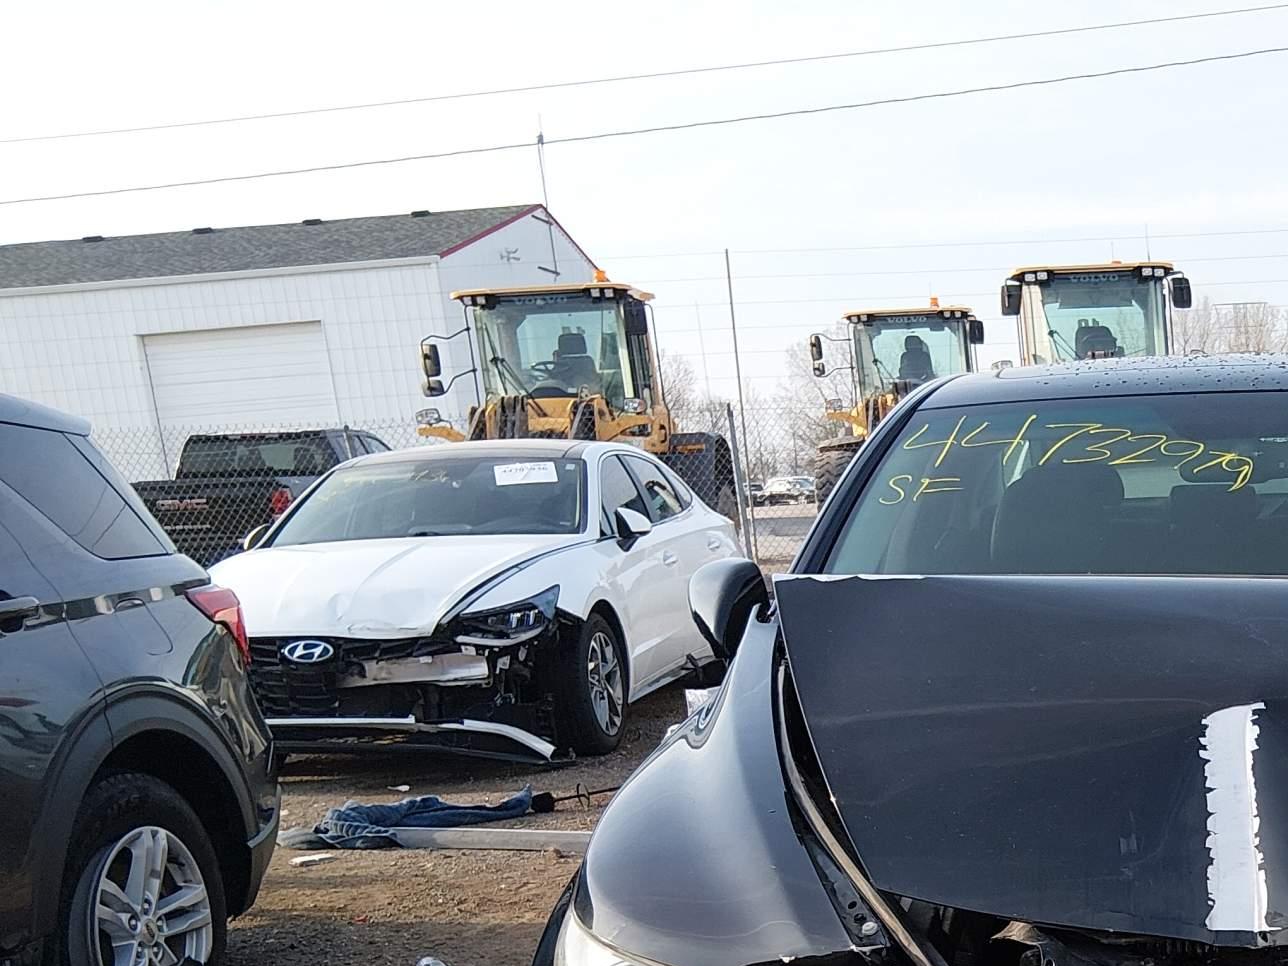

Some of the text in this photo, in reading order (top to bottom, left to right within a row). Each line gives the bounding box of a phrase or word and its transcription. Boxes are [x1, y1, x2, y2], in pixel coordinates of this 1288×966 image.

[887, 315, 927, 323] VOLVO
[903, 415, 1253, 493] 44732979
[879, 475, 964, 504] SF
[156, 499, 208, 511] GMC
